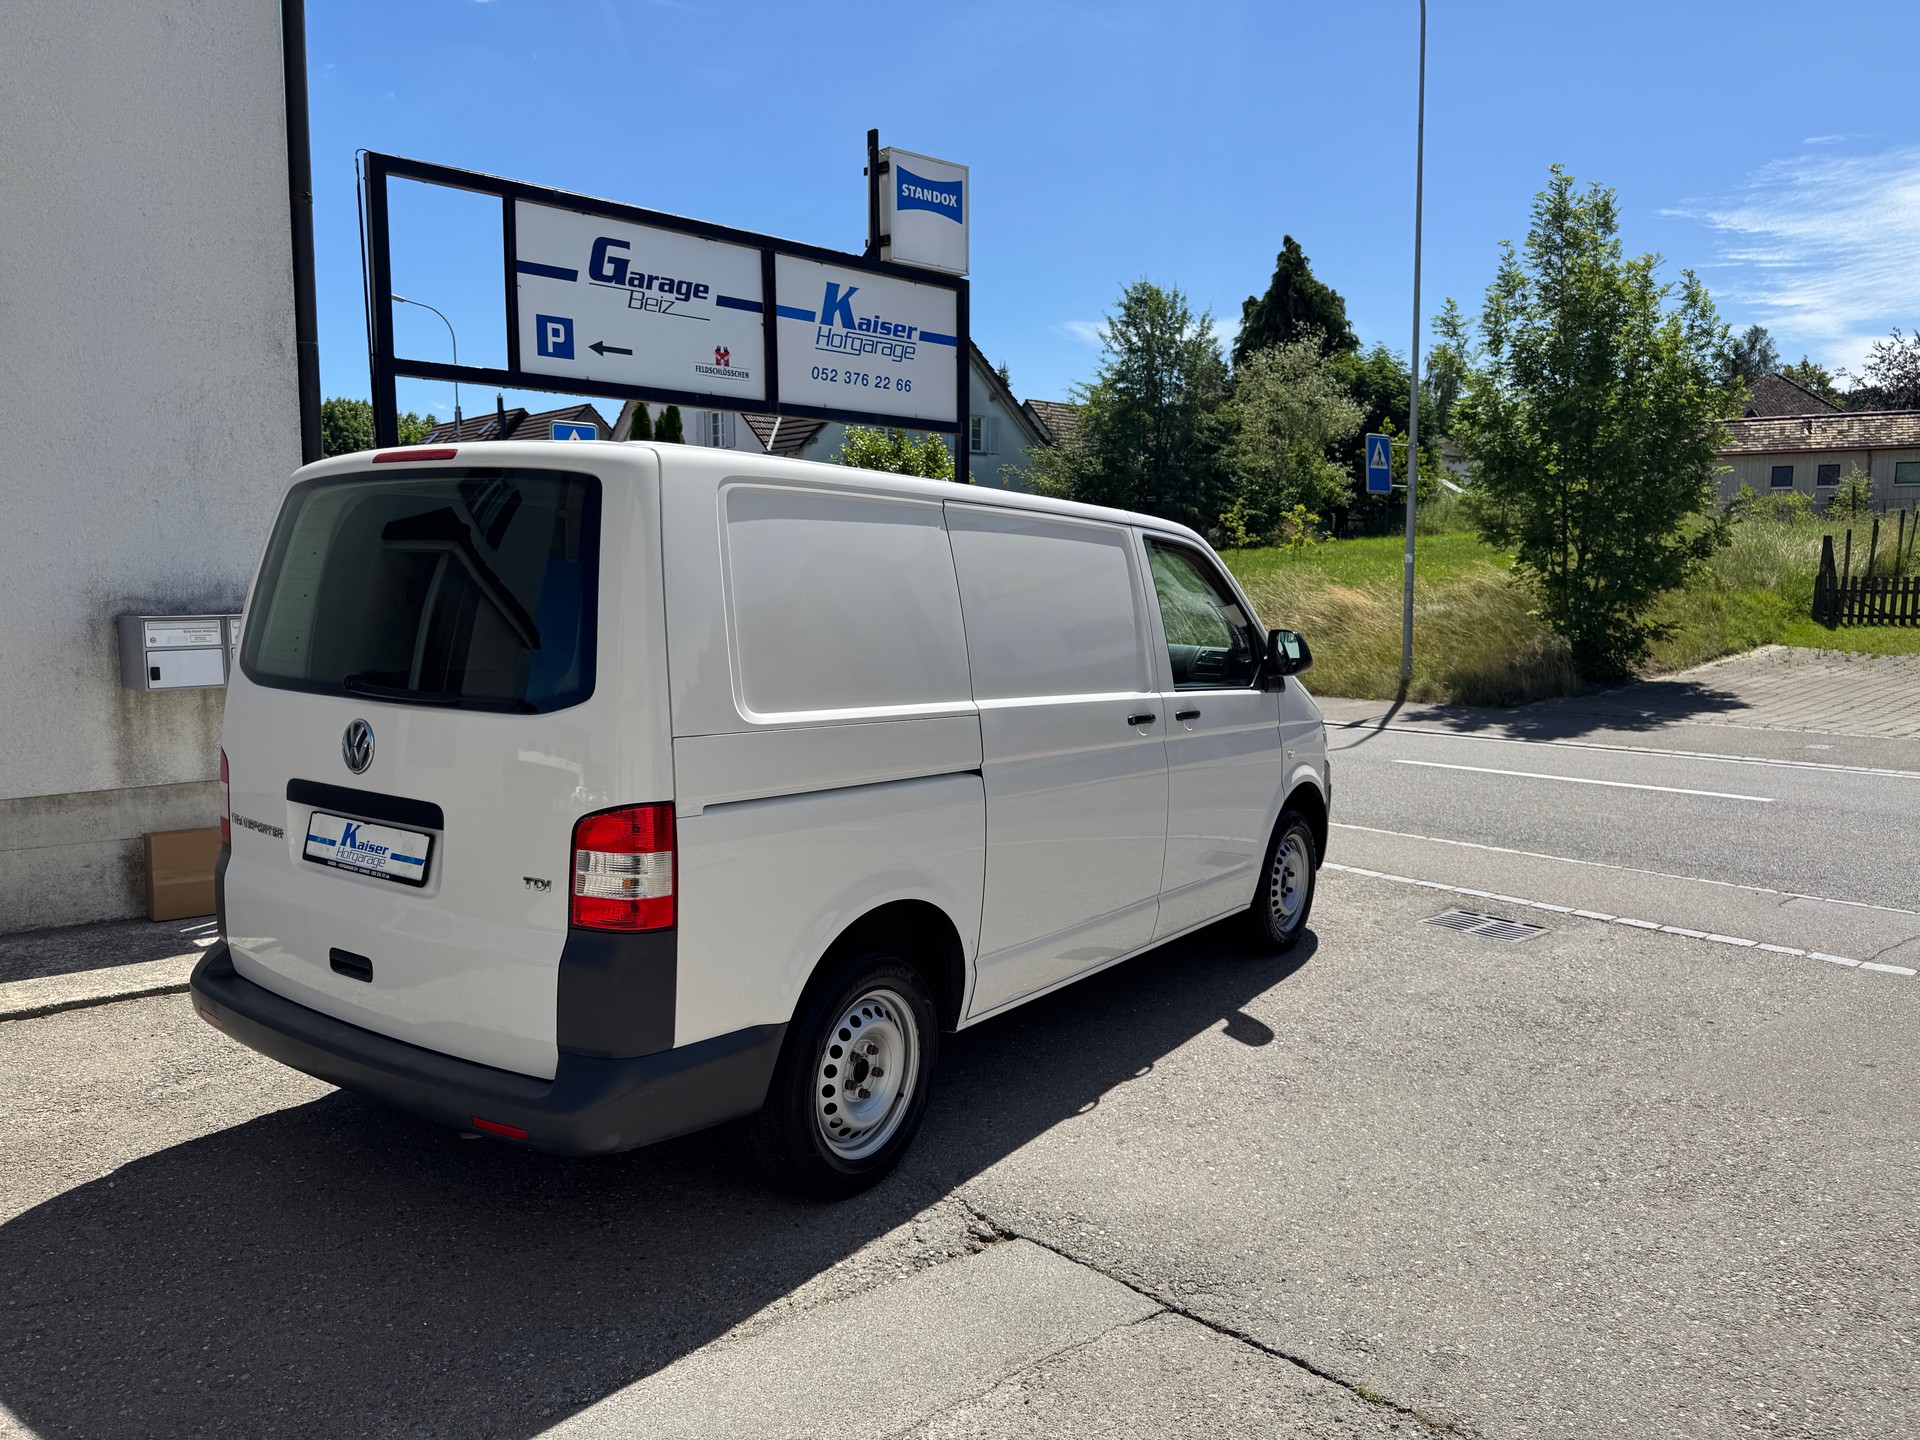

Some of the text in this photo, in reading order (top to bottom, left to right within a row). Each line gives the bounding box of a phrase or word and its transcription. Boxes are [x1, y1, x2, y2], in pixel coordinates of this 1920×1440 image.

[901, 183, 958, 208] STANDOX
[588, 236, 710, 303] Garage
[627, 289, 676, 314] Beiz
[819, 281, 918, 340] Kaiser
[546, 322, 565, 353] P
[815, 326, 917, 363] Hofgarage
[695, 364, 750, 379] FELDSCHLÖSSCHEN
[811, 366, 912, 393] 052 376 22 66
[340, 822, 389, 855] Kaiser
[335, 846, 387, 868] Hofgarage
[523, 876, 552, 893] TDI
